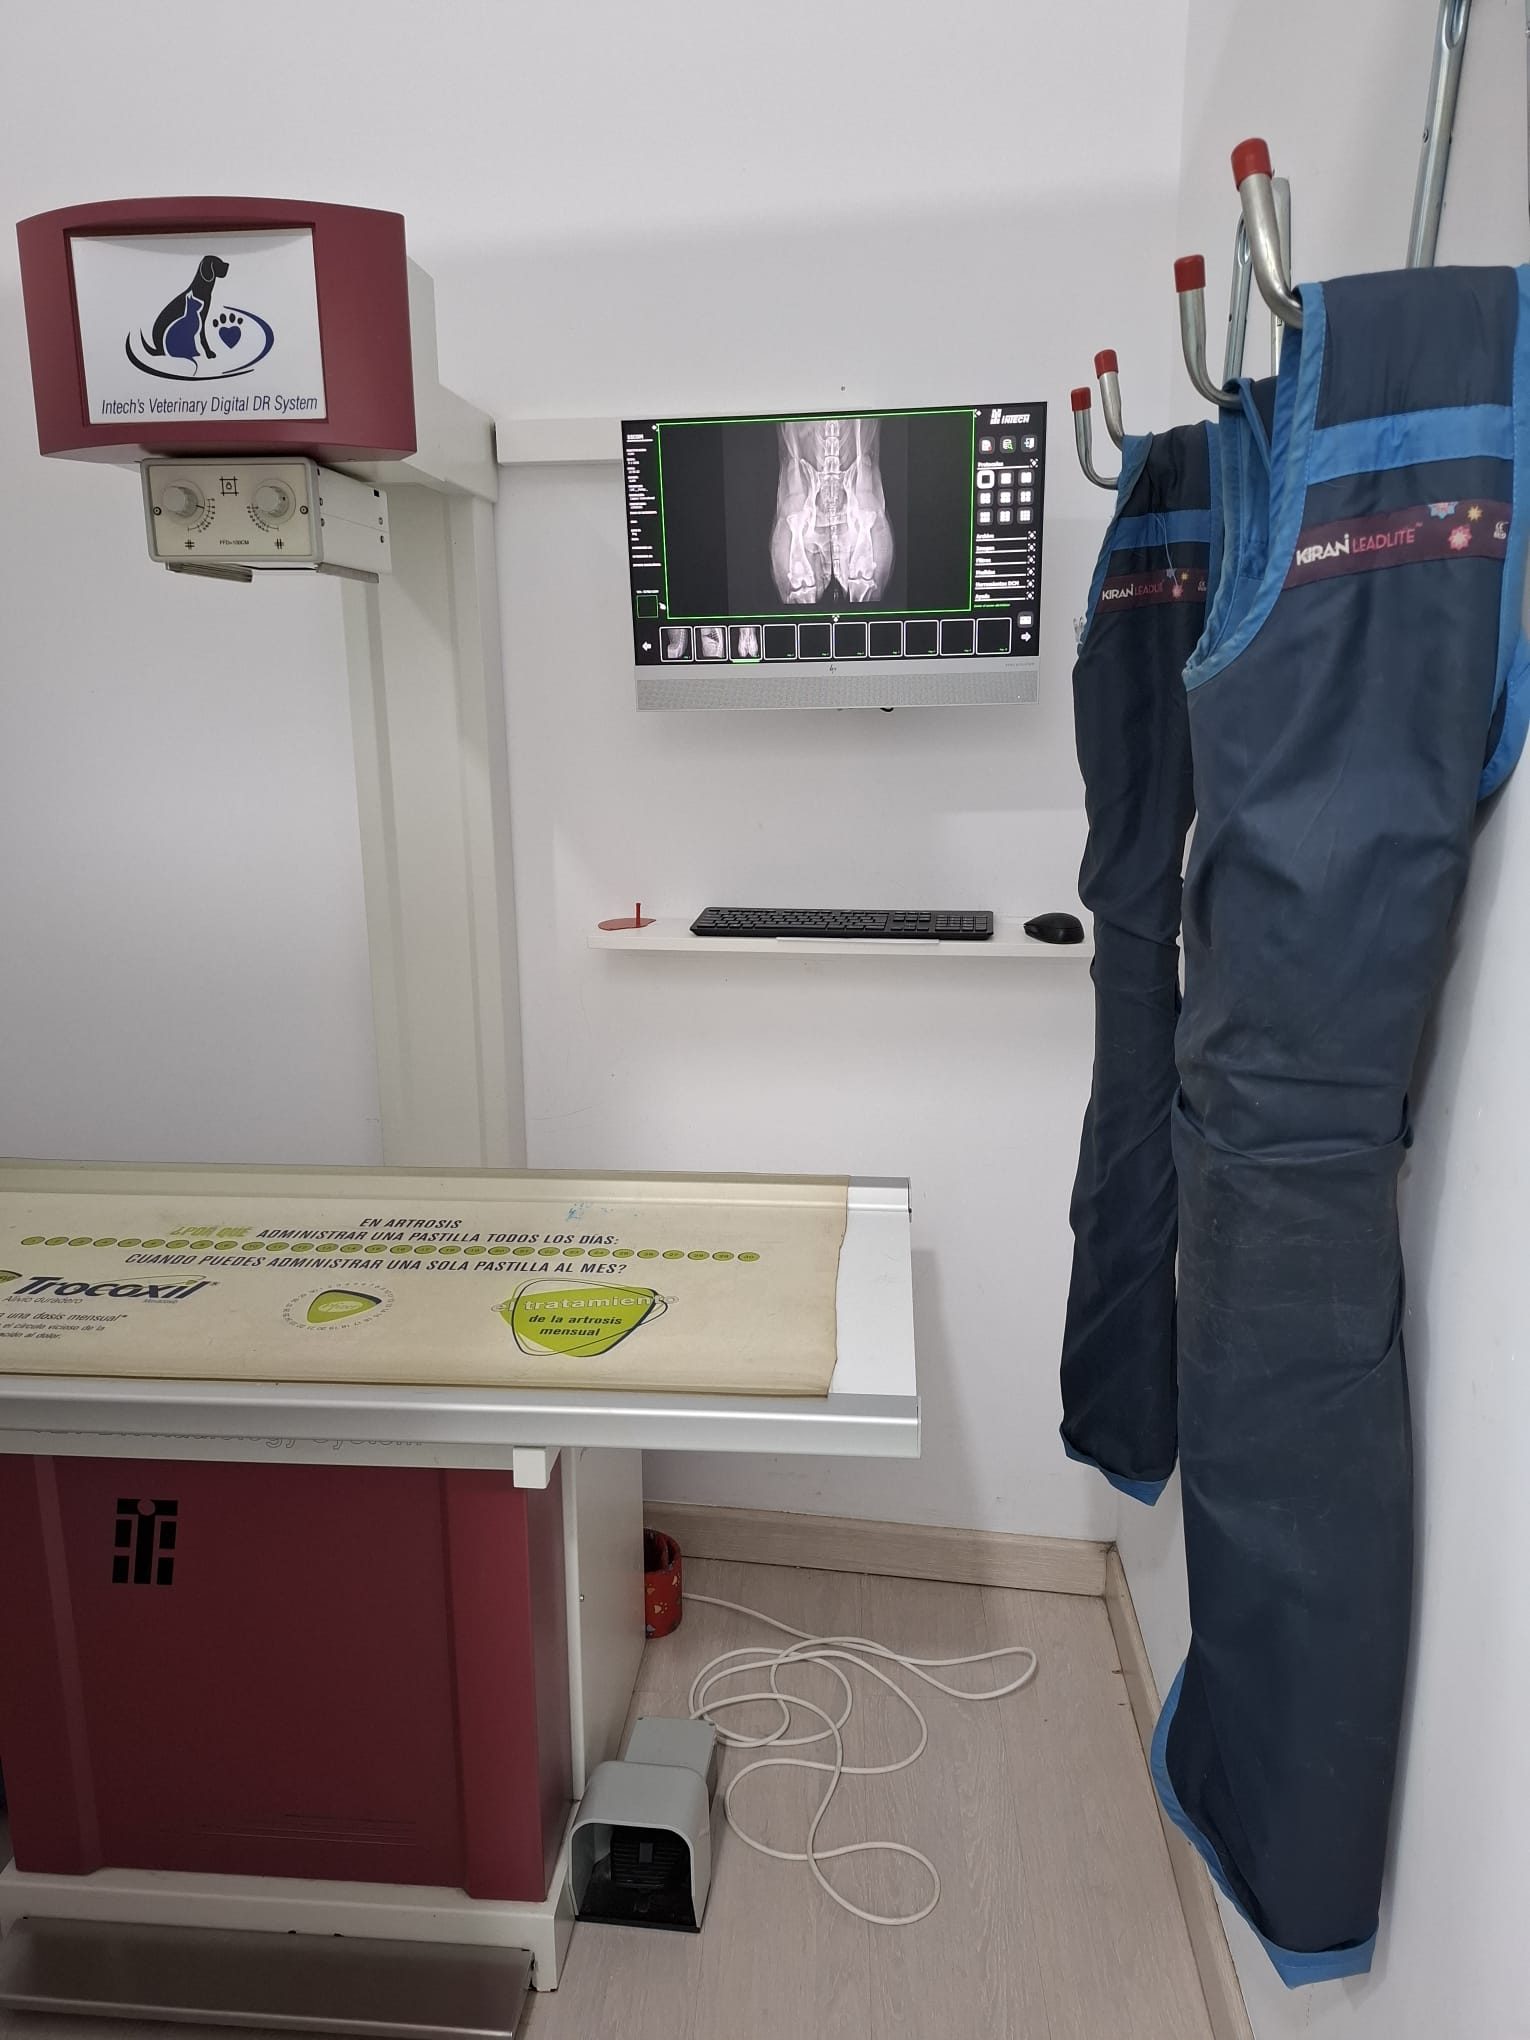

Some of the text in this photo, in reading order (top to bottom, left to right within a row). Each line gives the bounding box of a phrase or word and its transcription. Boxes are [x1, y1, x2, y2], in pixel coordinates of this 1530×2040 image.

[101, 395, 318, 416] Intech's Veterinary Digital DR System
[1352, 528, 1416, 554] LEADLITE
[360, 1218, 463, 1229] EN ARTROSIS
[256, 1229, 368, 1241] ADMINISTRAR
[371, 1231, 404, 1241] UNA
[408, 1232, 480, 1243] PASTILLA
[487, 1233, 540, 1244] TODOS
[543, 1234, 575, 1244] LOS
[579, 1233, 620, 1245] DÍAS:
[125, 1253, 627, 1274] CUANDO PUEDES ADMINISTRAR UNA SOLA PASTILLA AL MES?
[13, 1276, 211, 1298] Trocoxil
[490, 1292, 680, 1314] el tratamiento
[529, 1314, 623, 1325] de la artrosis
[539, 1327, 601, 1337] mensual
